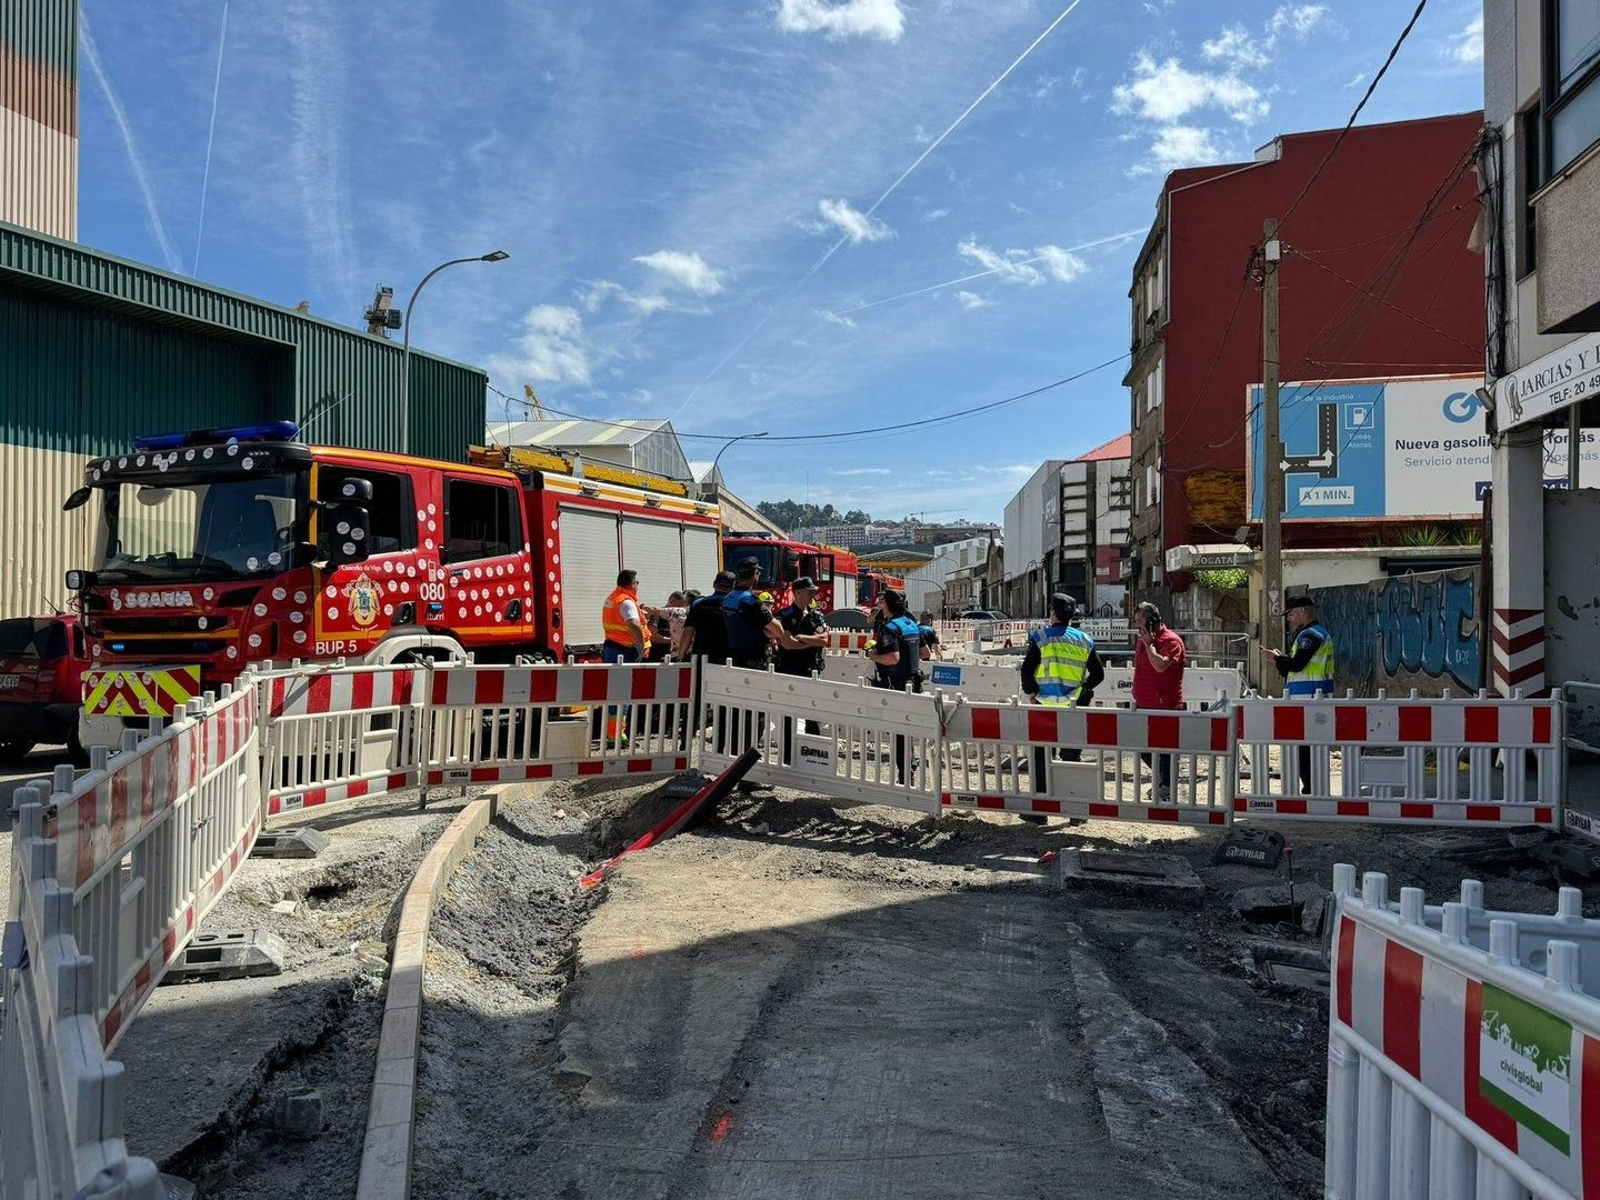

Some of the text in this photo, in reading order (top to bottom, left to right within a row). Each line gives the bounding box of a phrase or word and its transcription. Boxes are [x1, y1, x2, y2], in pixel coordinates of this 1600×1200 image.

[1521, 359, 1571, 397] JARCIAS
[1578, 350, 1589, 371] Y
[1574, 381, 1585, 395] 20
[1395, 439, 1439, 450] Nueva
[1404, 456, 1452, 468] Servicio
[1304, 490, 1351, 500] A 1 MIN.
[420, 582, 445, 601] 080
[315, 639, 358, 656] BUP. 5
[1500, 1059, 1543, 1094] civisglobal
